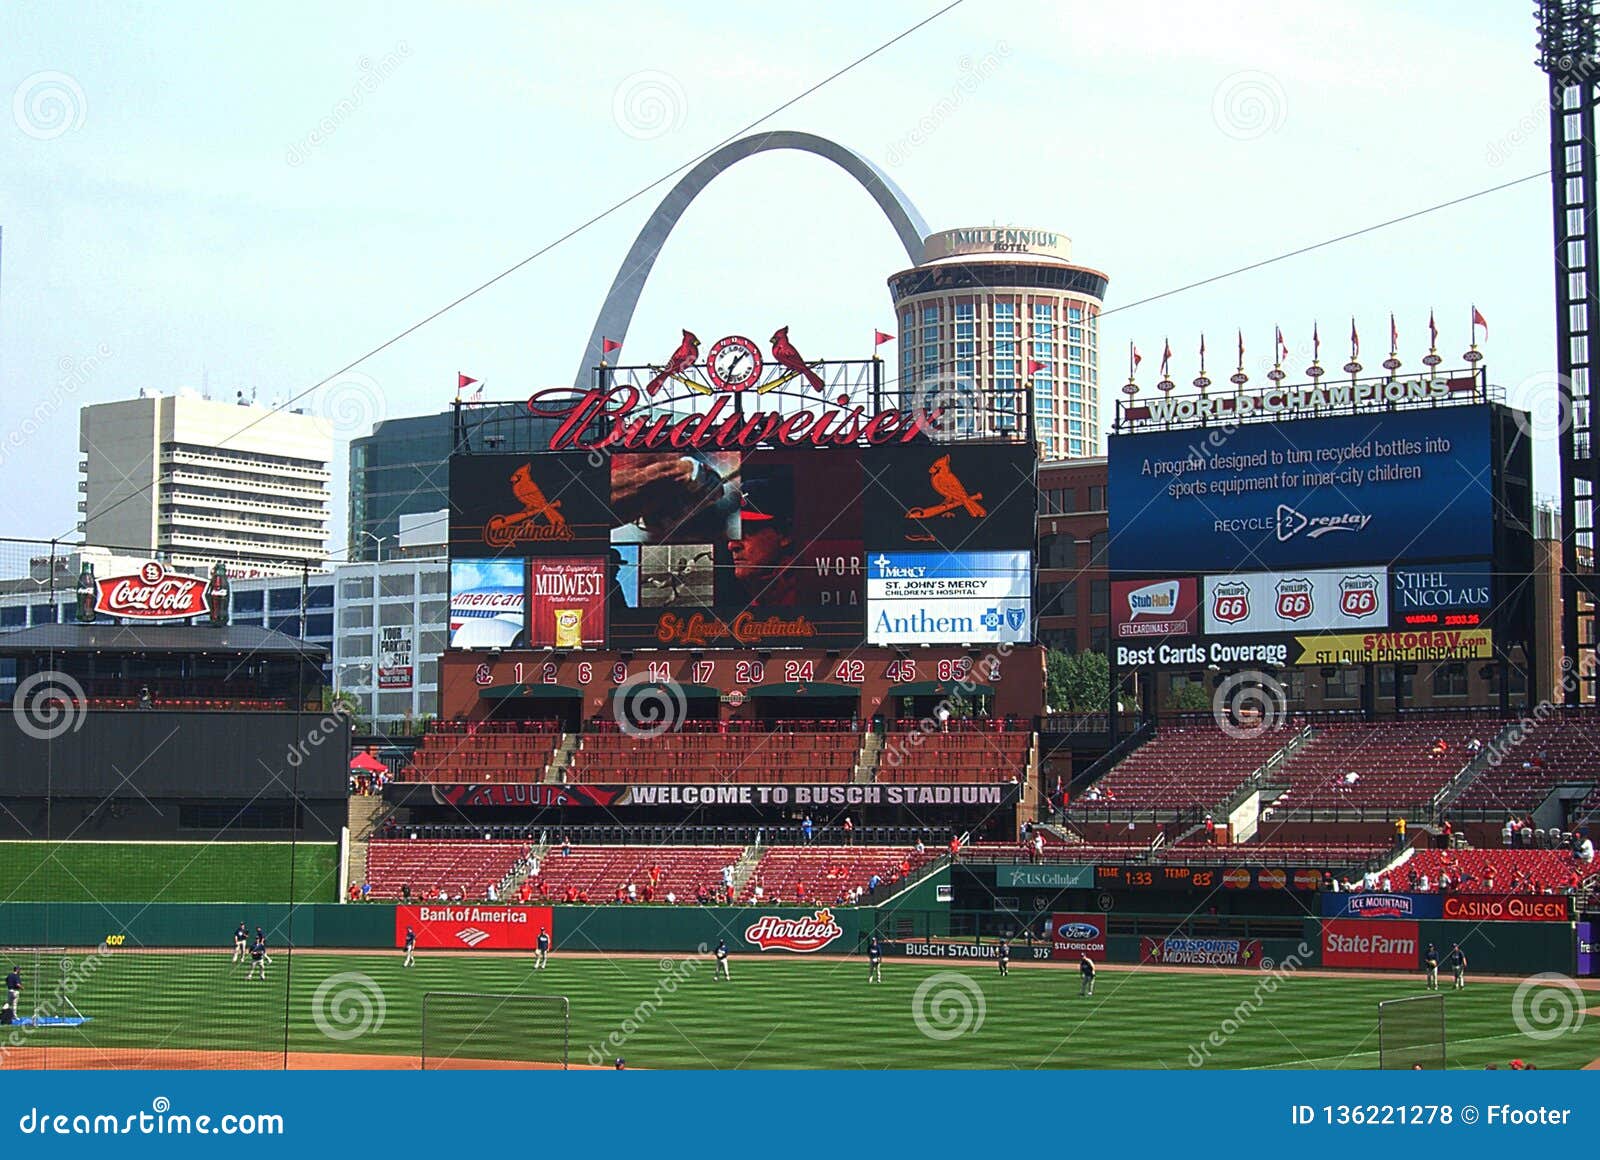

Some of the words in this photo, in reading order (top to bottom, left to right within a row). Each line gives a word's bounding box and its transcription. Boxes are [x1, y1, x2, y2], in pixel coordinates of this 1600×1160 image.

[954, 230, 1057, 249] MILLENNIUM
[993, 243, 1028, 252] HOTEL
[1149, 396, 1255, 422] WORLD
[1263, 377, 1449, 413] CHAMPIONS
[527, 387, 946, 450] Budweiser
[1141, 459, 1151, 475] A
[1154, 455, 1206, 478] program
[1210, 448, 1267, 474] designed
[1271, 449, 1284, 466] to
[1287, 447, 1312, 464] turn
[1316, 440, 1371, 465] recycled
[1375, 437, 1421, 457] bottles
[1425, 437, 1450, 453] into
[1168, 479, 1207, 500] sports
[1210, 473, 1278, 495] equipment
[1281, 471, 1299, 489] for
[1302, 466, 1364, 488] inner-city
[1367, 463, 1421, 483] children
[483, 514, 576, 548] Cardinals
[1214, 518, 1273, 532] RECYCLE
[1285, 516, 1293, 529] 2
[1308, 512, 1372, 534] replay
[815, 556, 861, 577] WOR
[535, 573, 604, 595] MIDWEST
[885, 581, 900, 589] ST.
[904, 580, 945, 589] JOHN'S
[948, 580, 988, 589] MERCY
[1280, 584, 1308, 593] PHILLIPS
[1344, 580, 1373, 590] PHILLIPS
[1396, 571, 1447, 589] STIFEL
[451, 591, 524, 609] American
[936, 588, 976, 596] HOSPITAL
[1131, 589, 1175, 608] StubHub!
[1217, 588, 1245, 596] PHILLIPS
[1404, 587, 1489, 608] NICOLAUS
[1219, 600, 1242, 616] 66
[1282, 597, 1305, 613] 66
[1346, 593, 1370, 610] 66
[732, 611, 817, 643] Cardinals
[874, 608, 974, 634] Anthem
[1117, 646, 1155, 666] Best
[1159, 644, 1206, 664] Cards
[1210, 642, 1287, 665] Coverage
[514, 662, 524, 684] 1
[543, 662, 557, 684] 2
[578, 662, 592, 684] 6
[613, 662, 627, 684] 9
[649, 662, 670, 683] 14
[692, 661, 714, 683] 17
[736, 660, 764, 683] 20
[785, 660, 814, 683] 24
[836, 660, 864, 682] 42
[886, 660, 916, 682] 45
[938, 659, 967, 681] 85
[632, 787, 751, 804] WELCOME
[757, 787, 784, 804] TO
[795, 786, 881, 804] BUSCH
[887, 787, 1002, 804] STADIUM
[1043, 873, 1080, 885] Cellular
[1097, 867, 1120, 877] TIME
[1125, 872, 1153, 885] 1:33
[1164, 868, 1190, 879] TEMP
[1351, 899, 1364, 909] ICE
[1365, 897, 1409, 911] MOUNTAIN
[1445, 899, 1503, 917] CASINO
[1508, 900, 1566, 918] QUEEN
[420, 908, 453, 923] Bank
[455, 908, 470, 922] of
[470, 909, 527, 923] America
[1065, 927, 1090, 940] Ford
[906, 943, 944, 956] BUSCH
[948, 944, 999, 958] STADIUM
[1055, 943, 1104, 951] STLFORD.COM
[1162, 951, 1238, 965] MIDWEST.COM
